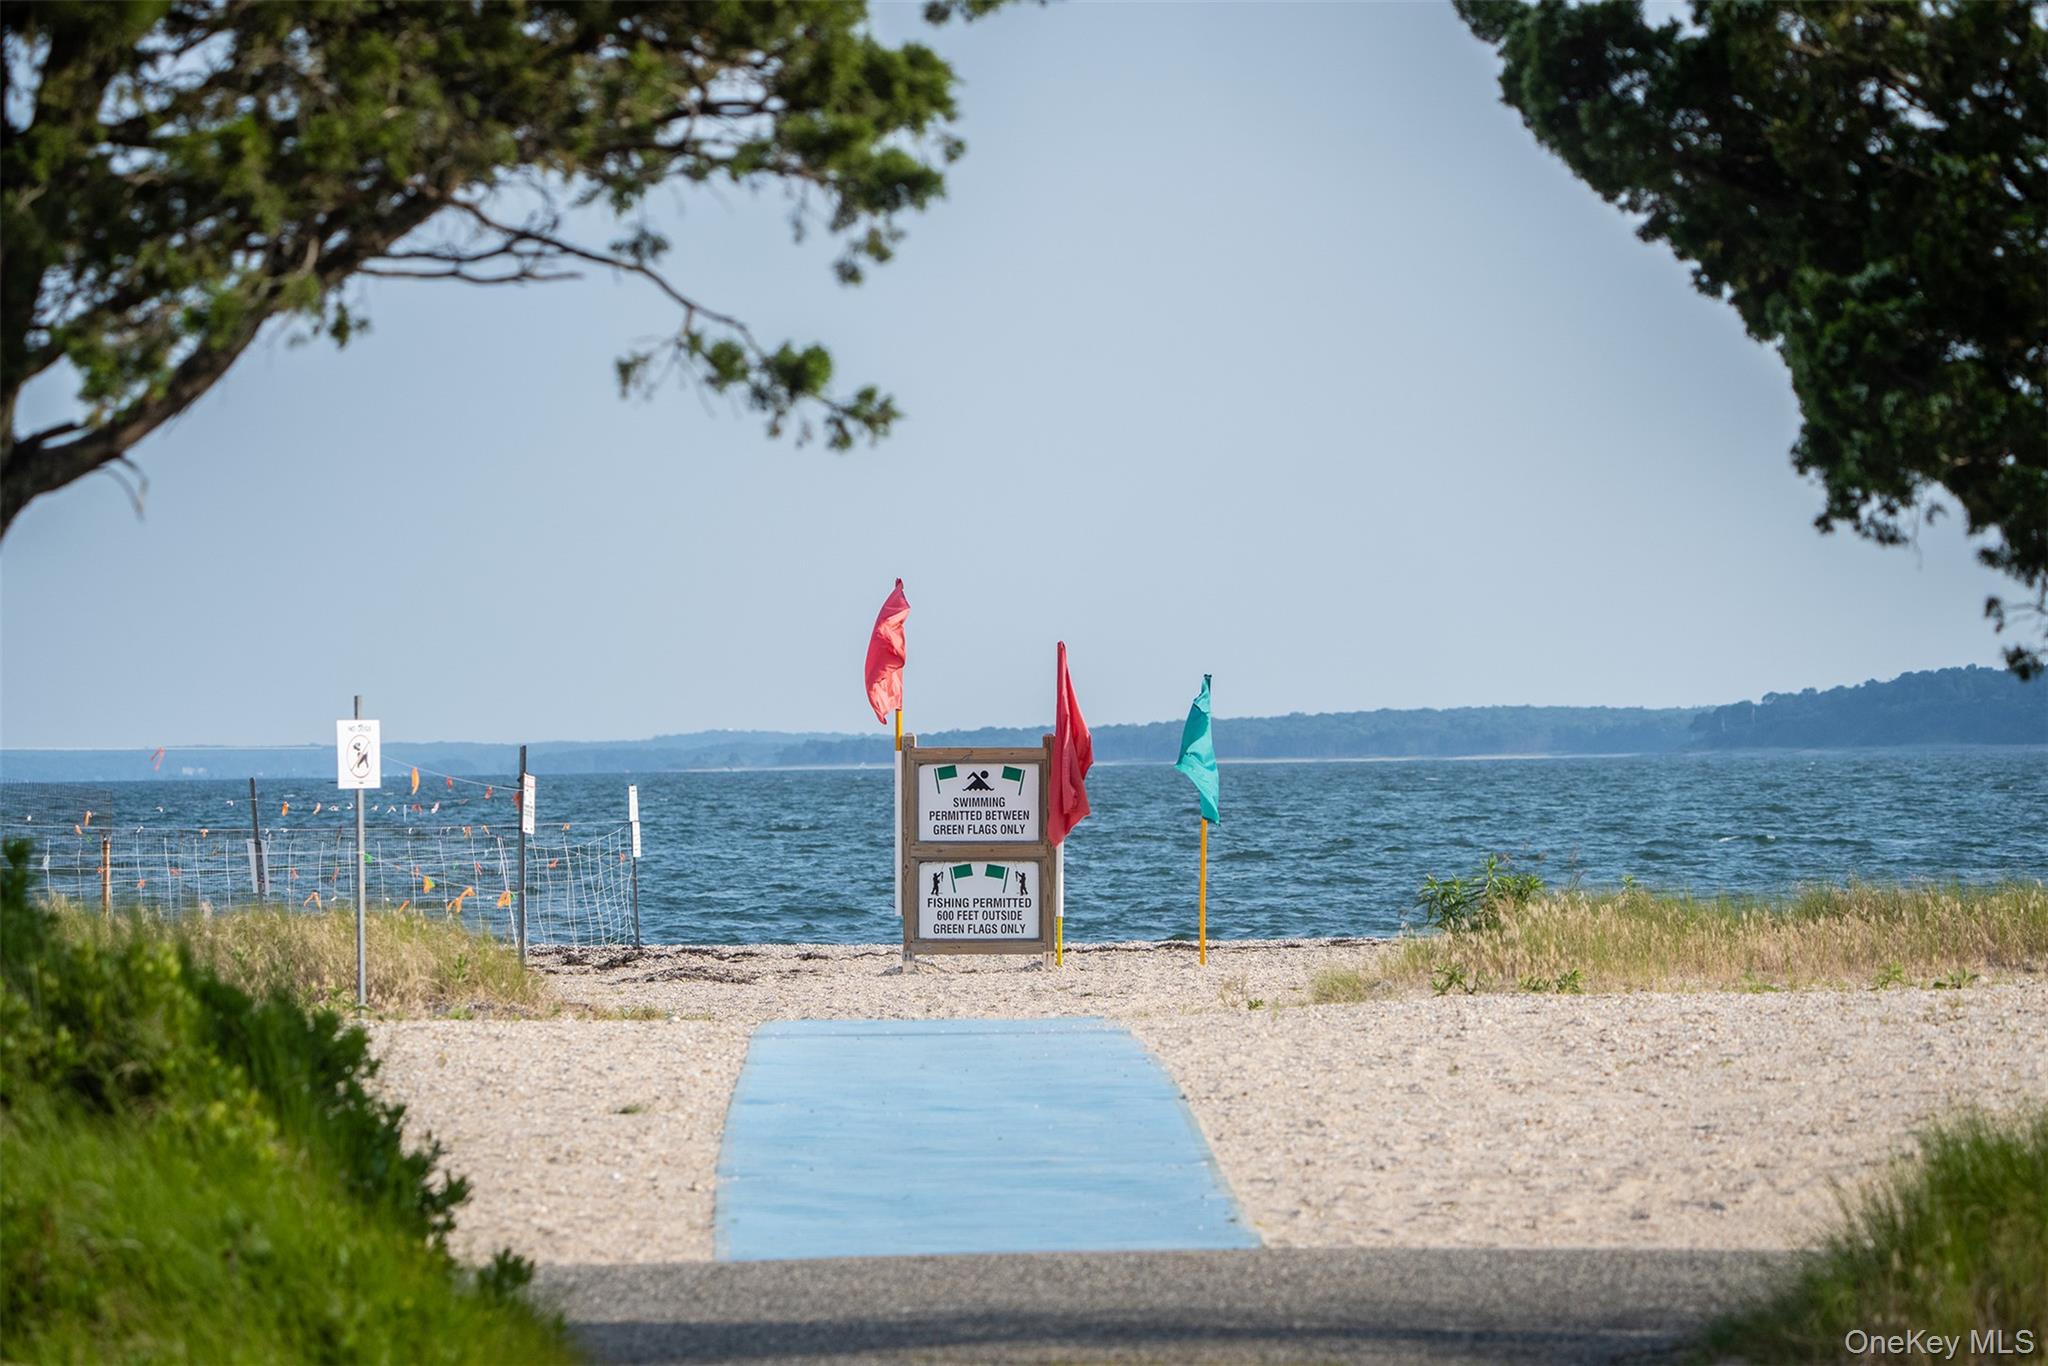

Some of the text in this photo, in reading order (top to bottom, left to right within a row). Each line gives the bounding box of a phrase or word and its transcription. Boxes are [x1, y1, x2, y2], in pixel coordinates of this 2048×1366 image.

[953, 797, 1006, 807] SWIMMING
[929, 810, 1030, 821] PERMITTED BETWEEN
[933, 824, 1026, 835] GREEN FLAGS ONLY
[927, 898, 1032, 908] FISHING PERMITTED
[937, 910, 1022, 921] 600 FEET OUTSIDE
[933, 924, 1026, 934] GREEN FLAGS ONLY
